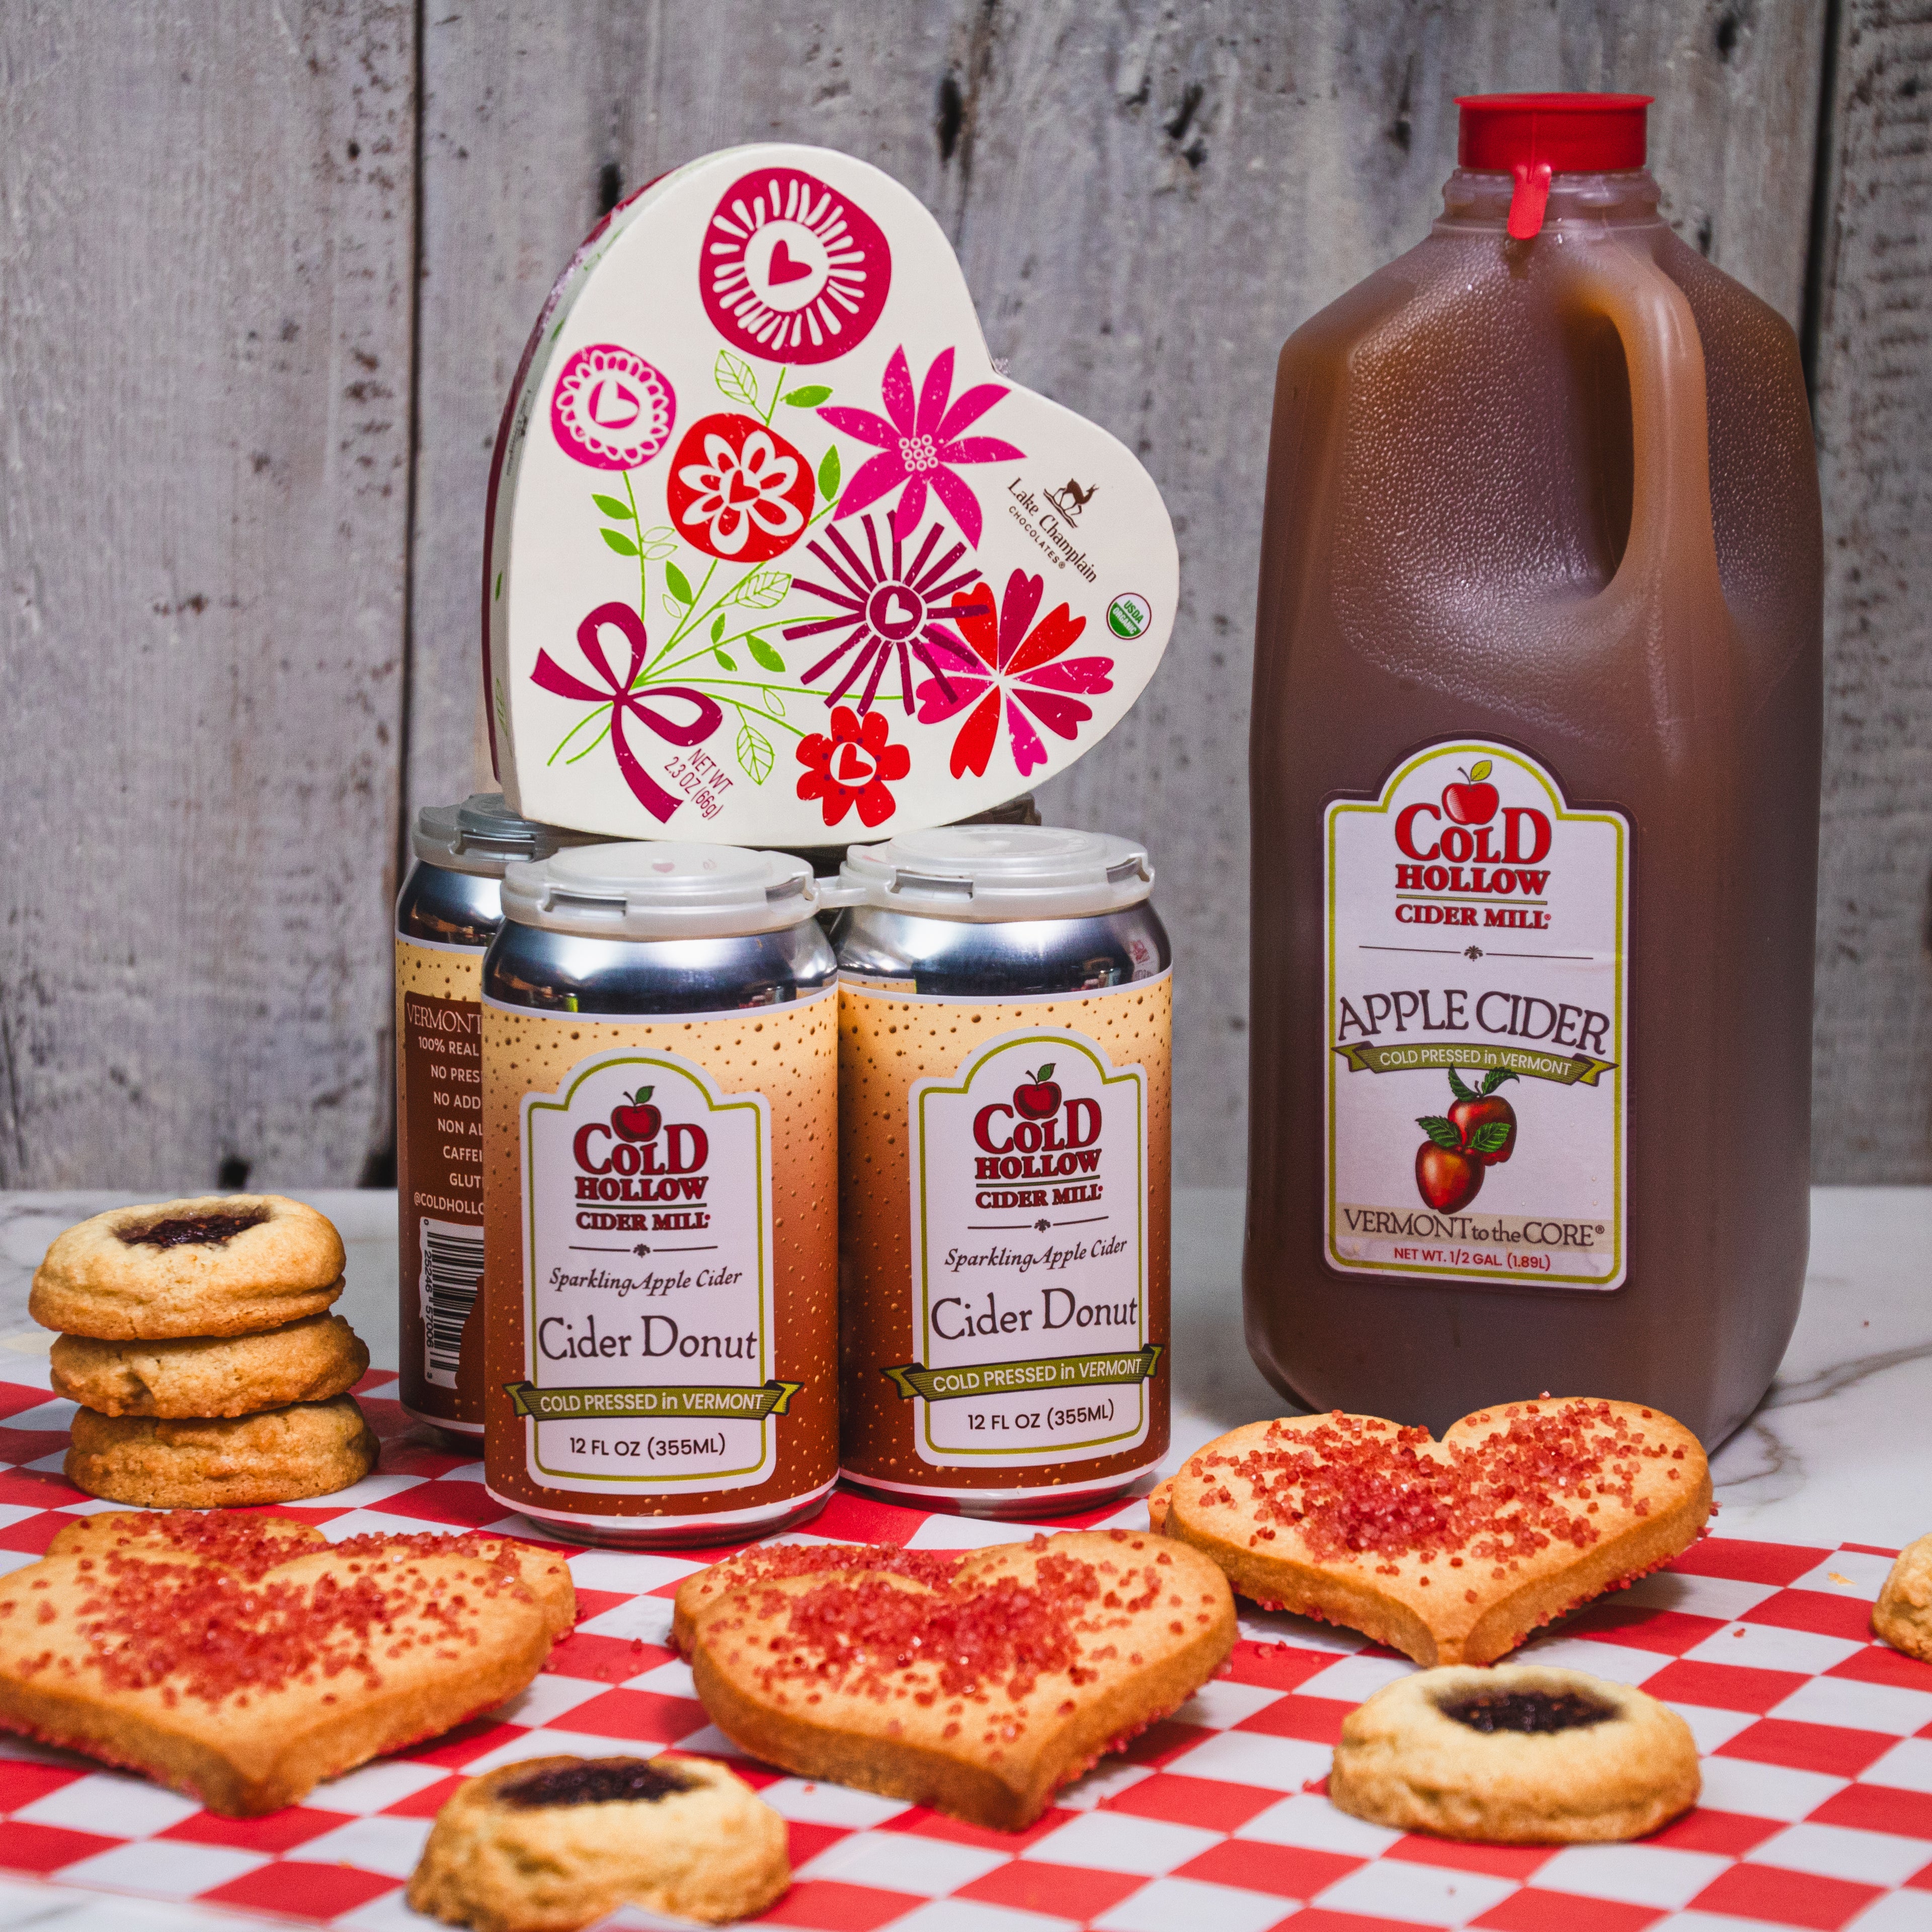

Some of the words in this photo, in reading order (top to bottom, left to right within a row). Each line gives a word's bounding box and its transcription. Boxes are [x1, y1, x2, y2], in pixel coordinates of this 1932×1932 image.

[1008, 477, 1039, 517] Lake
[1038, 514, 1097, 583] Champlain
[1112, 607, 1137, 634] ORGANIC
[1124, 600, 1144, 624] USDA
[688, 748, 716, 776] NET
[708, 769, 734, 794] WT
[664, 756, 686, 778] 2.3
[679, 772, 701, 794] OZ
[691, 786, 723, 820] (66g)
[1395, 802, 1552, 864] COLD
[1395, 864, 1550, 895] HOLLOW
[1395, 904, 1477, 926] CIDER
[407, 1003, 481, 1034] VERMONT
[1338, 989, 1469, 1041] APPLE
[1475, 991, 1610, 1055] CIDER
[418, 1036, 445, 1053] 100%
[449, 1041, 479, 1057] REAL
[431, 1064, 447, 1079] NO
[451, 1068, 482, 1084] PRES
[1380, 1051, 1418, 1066] COLD
[1421, 1049, 1481, 1064] PRESSED
[1484, 1050, 1497, 1065] in
[1501, 1053, 1572, 1076] VERMONT
[434, 1091, 449, 1105] NO
[438, 1118, 464, 1134] NON
[973, 1097, 1102, 1154] COLD
[573, 1122, 708, 1176] COLD
[975, 1148, 1102, 1179] HOLLOW
[449, 1173, 483, 1188] GLUT
[575, 1176, 709, 1201] HOLLOW
[975, 1189, 1049, 1209] CIDER
[576, 1212, 648, 1231] CIDER
[1344, 1209, 1472, 1239] VERMONT
[1472, 1224, 1489, 1241] to
[1491, 1220, 1521, 1243] the
[944, 1246, 1034, 1272] Sparkling
[1032, 1241, 1086, 1270] Apple
[1090, 1235, 1128, 1257] Cider
[1394, 1248, 1419, 1261] NET
[1422, 1250, 1446, 1263] WT.
[1450, 1249, 1470, 1264] 1/2
[1473, 1253, 1502, 1266] GAL.
[1507, 1254, 1550, 1271] (1.89L)
[424, 1250, 433, 1293] 25246
[549, 1267, 633, 1297] Sparkling
[632, 1270, 691, 1296] Apple
[696, 1266, 743, 1287] Cider
[931, 1292, 1032, 1340] Cider
[1041, 1287, 1138, 1330] Donut
[539, 1314, 631, 1360] Cider
[641, 1315, 757, 1359] Donut
[933, 1374, 979, 1392] COLD
[985, 1366, 1056, 1388] PRESSED
[1060, 1363, 1075, 1380] in
[1079, 1358, 1142, 1378] VERMONT
[540, 1396, 580, 1412] COLD
[585, 1394, 658, 1410] PRESSED
[662, 1392, 678, 1409] in
[683, 1394, 764, 1410] VERMONT
[968, 1414, 985, 1430] 12
[992, 1415, 1009, 1430] FL
[1015, 1413, 1040, 1429] OZ
[1047, 1399, 1114, 1430] (355ML)
[570, 1437, 586, 1454] 12
[591, 1439, 609, 1456] FL
[614, 1441, 640, 1456] OZ
[648, 1432, 726, 1459] (355ML)
